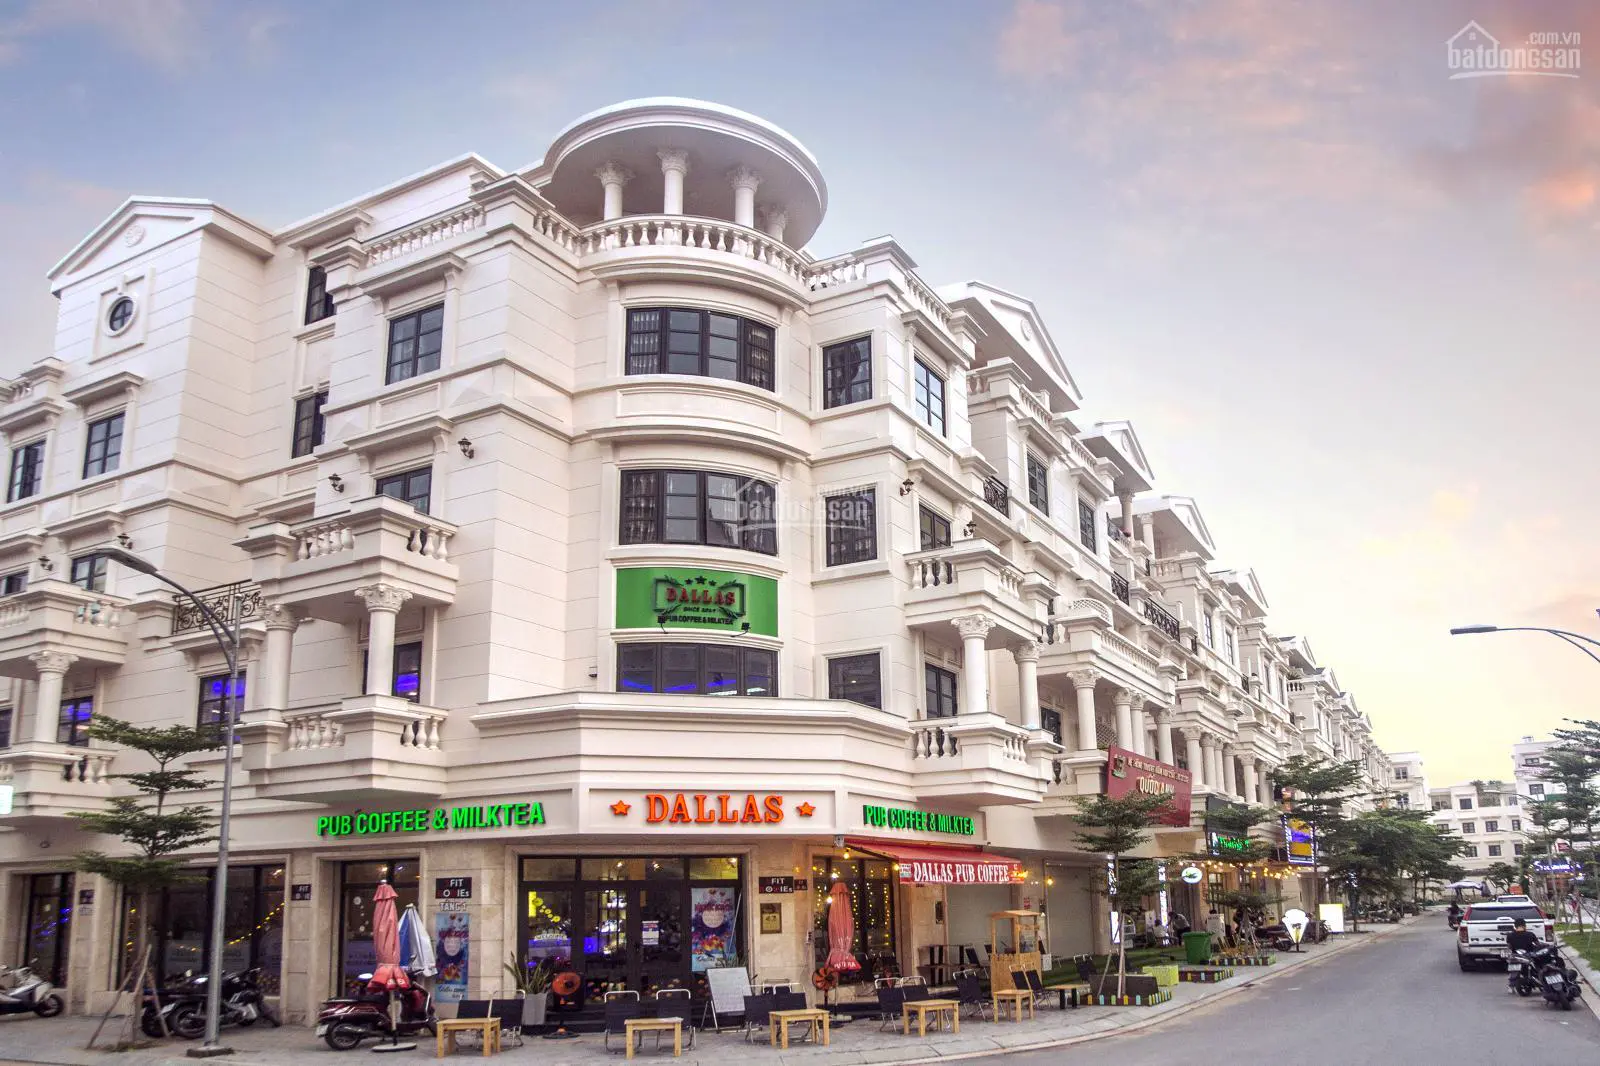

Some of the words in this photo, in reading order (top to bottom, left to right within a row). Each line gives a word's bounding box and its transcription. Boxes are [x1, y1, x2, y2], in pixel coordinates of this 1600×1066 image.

[666, 588, 736, 605] DALLAS
[317, 815, 352, 836] PUB
[356, 809, 428, 834] COFFEE
[433, 808, 448, 831] &
[451, 802, 545, 829] MILKTEA
[646, 793, 785, 825] DALLAS
[863, 804, 887, 828] PUB
[888, 808, 927, 833] COFFEE
[929, 812, 936, 832] &
[937, 813, 975, 836] MILKTEA
[771, 877, 785, 885] FIT
[913, 861, 953, 883] DALLAS
[955, 863, 975, 883] PUB
[977, 864, 1009, 883] COFFEE
[450, 879, 464, 888] FIT
